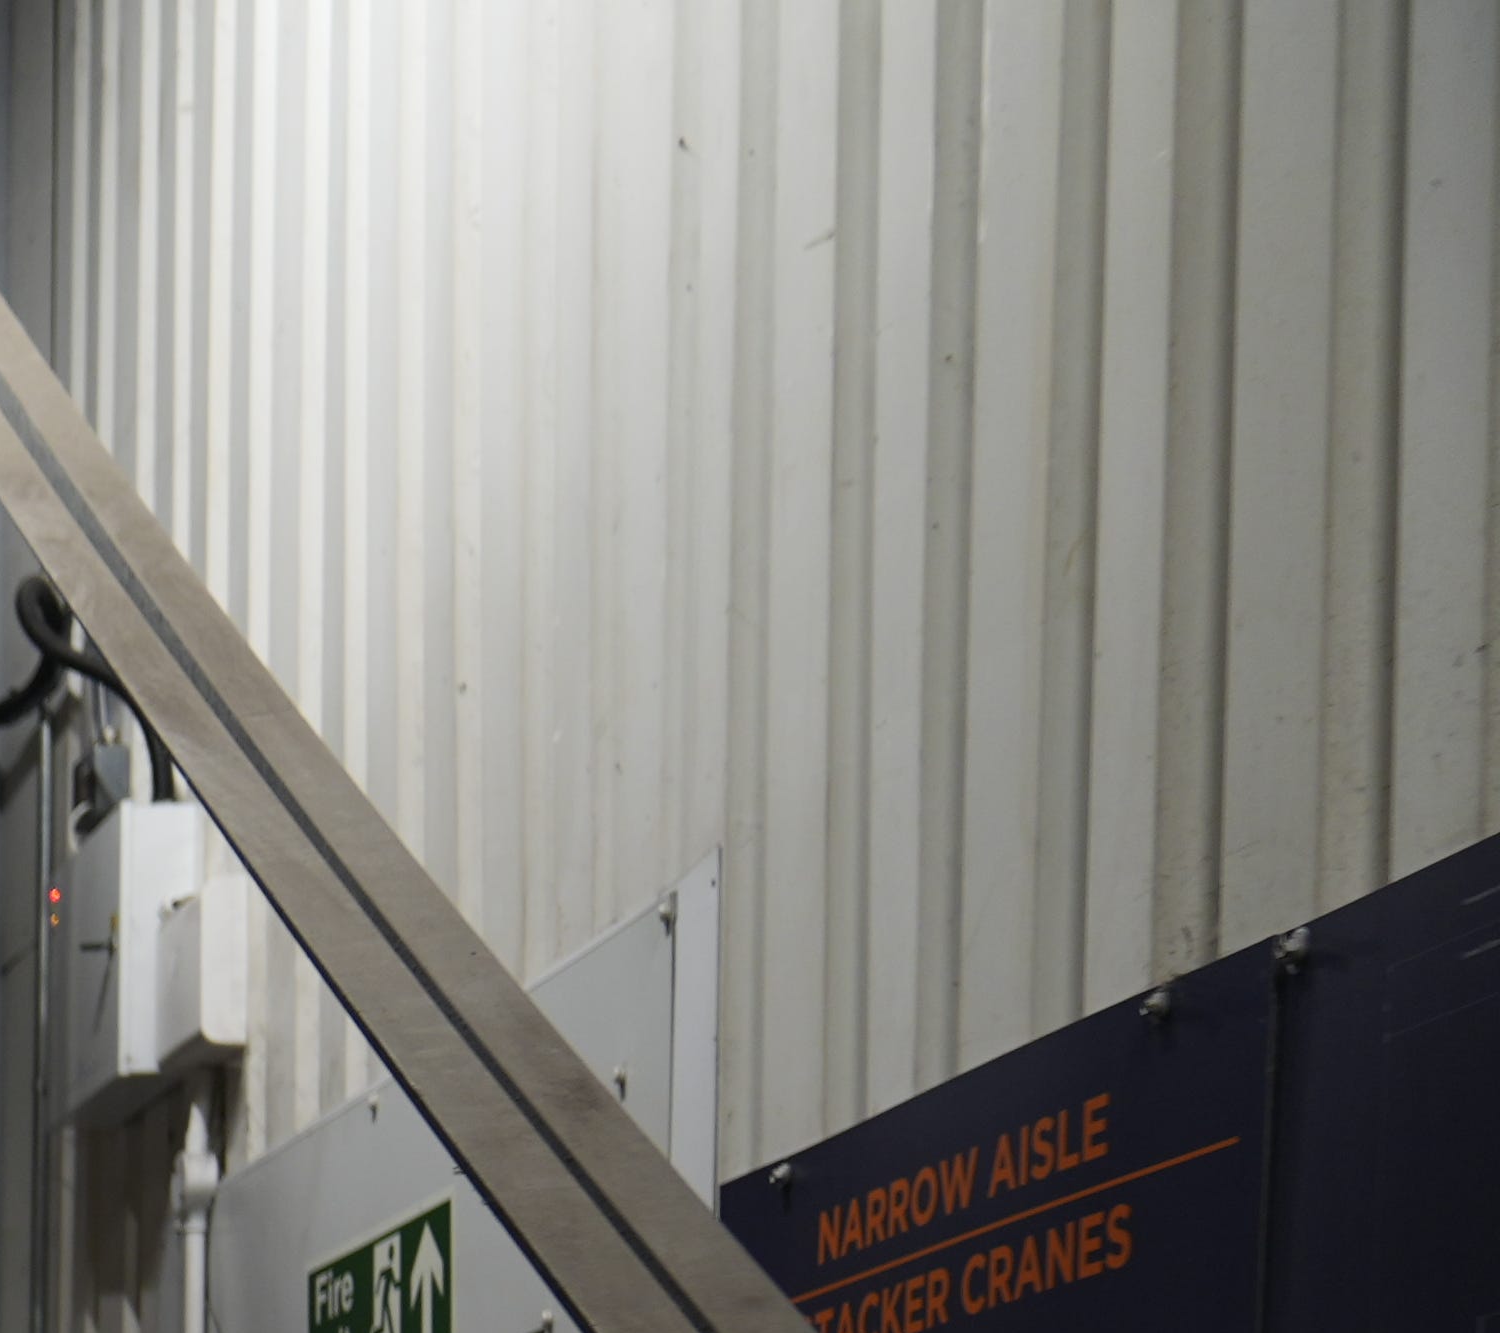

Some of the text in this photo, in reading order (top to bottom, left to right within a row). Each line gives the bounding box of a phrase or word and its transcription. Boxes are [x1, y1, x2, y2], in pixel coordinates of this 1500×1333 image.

[819, 1093, 1112, 1266] NARROW AISLE
[314, 1269, 353, 1325] Fire
[960, 1203, 1132, 1315] CRANES
